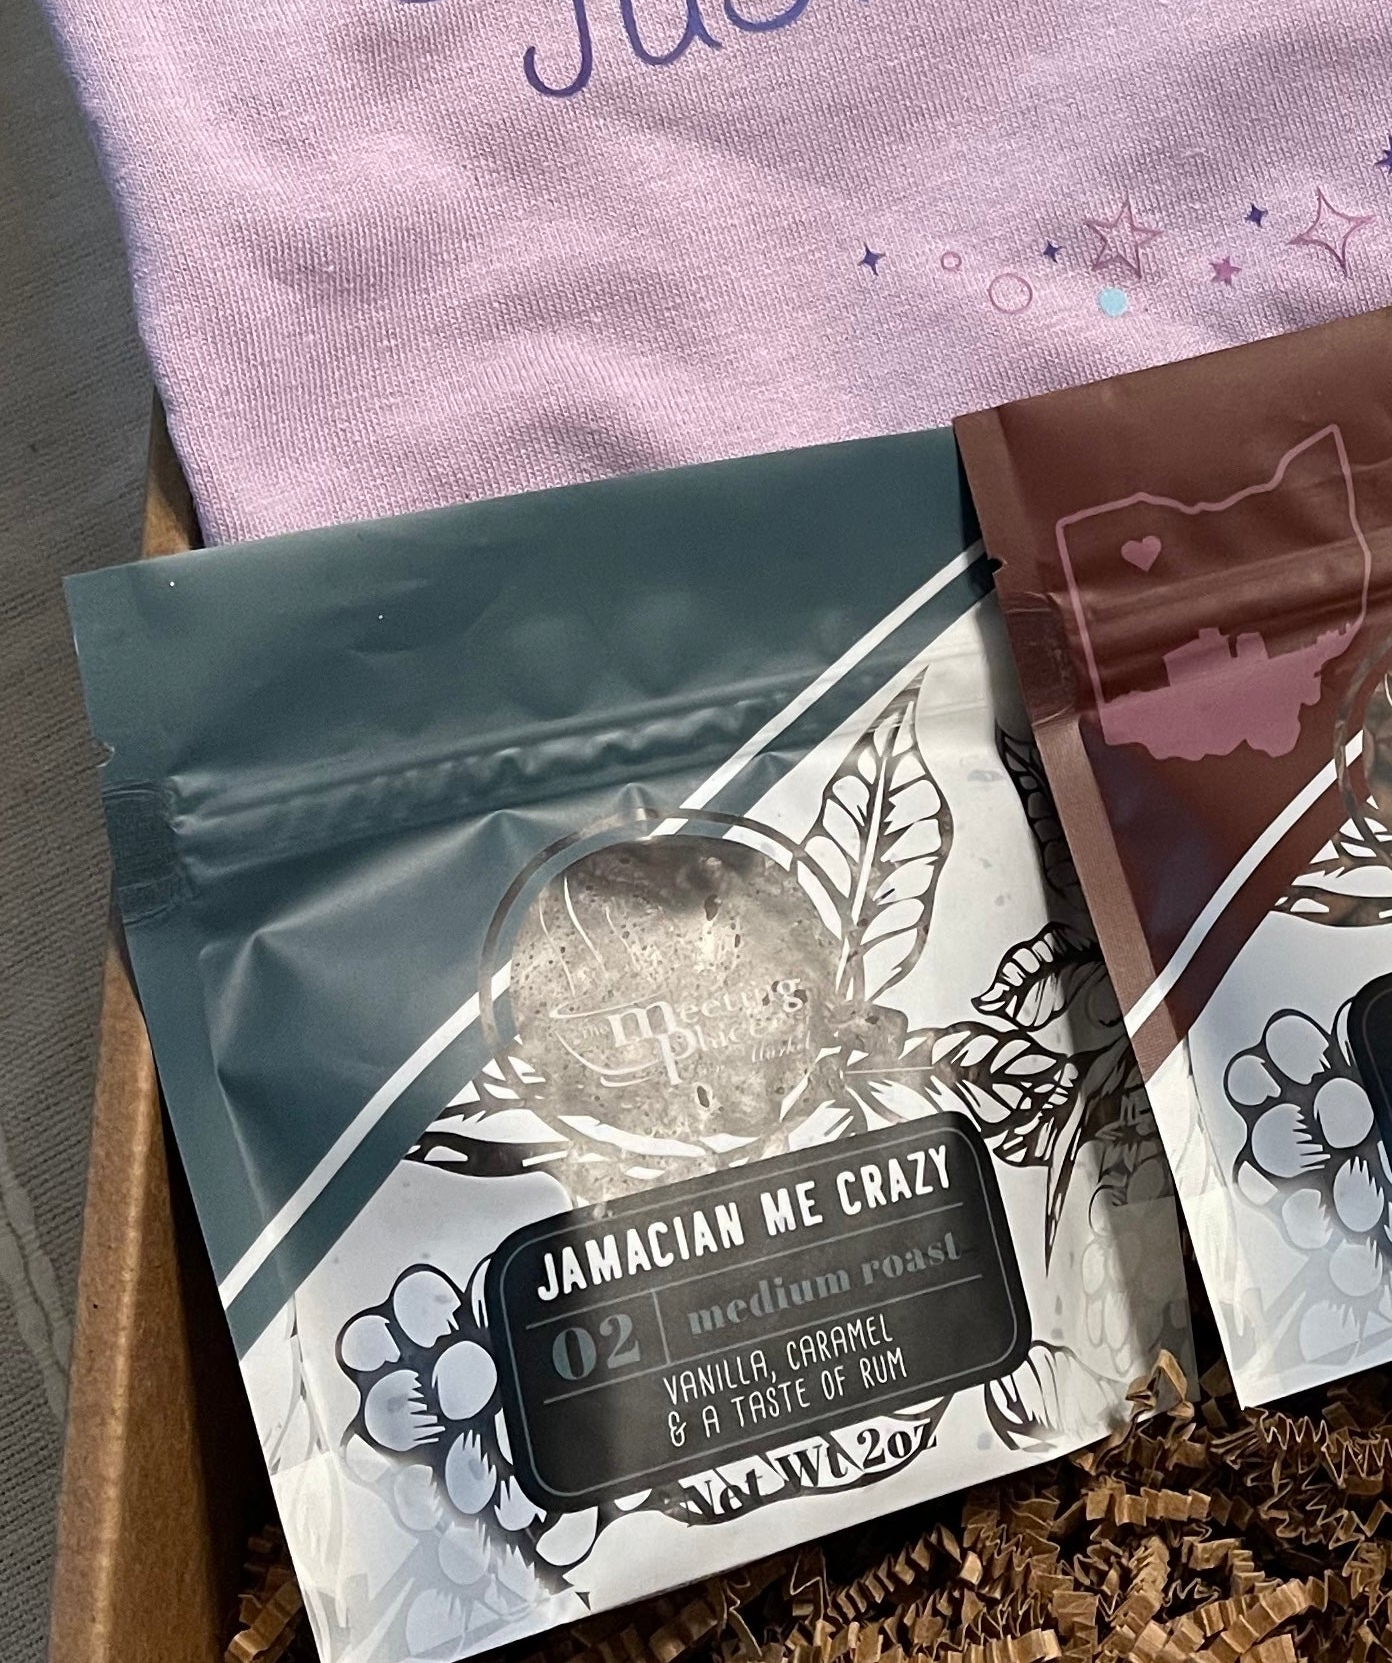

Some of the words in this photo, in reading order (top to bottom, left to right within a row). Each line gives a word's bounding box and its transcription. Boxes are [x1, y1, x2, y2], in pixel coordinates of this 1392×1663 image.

[537, 1202, 745, 1301] JAMACIAN
[760, 1181, 823, 1236] ME
[837, 1145, 950, 1215] CRAZY
[551, 1312, 641, 1381] 02
[687, 1266, 851, 1335] medium
[861, 1230, 963, 1285] roast
[662, 1350, 777, 1405] VANILLA,
[786, 1313, 893, 1369] CARAMEL
[667, 1411, 687, 1447] &
[701, 1404, 721, 1438] A
[730, 1377, 810, 1428] TASTE
[821, 1365, 846, 1400] OF
[860, 1346, 908, 1389] RUM
[775, 1443, 849, 1487] Wt
[856, 1418, 938, 1470] 2oz
